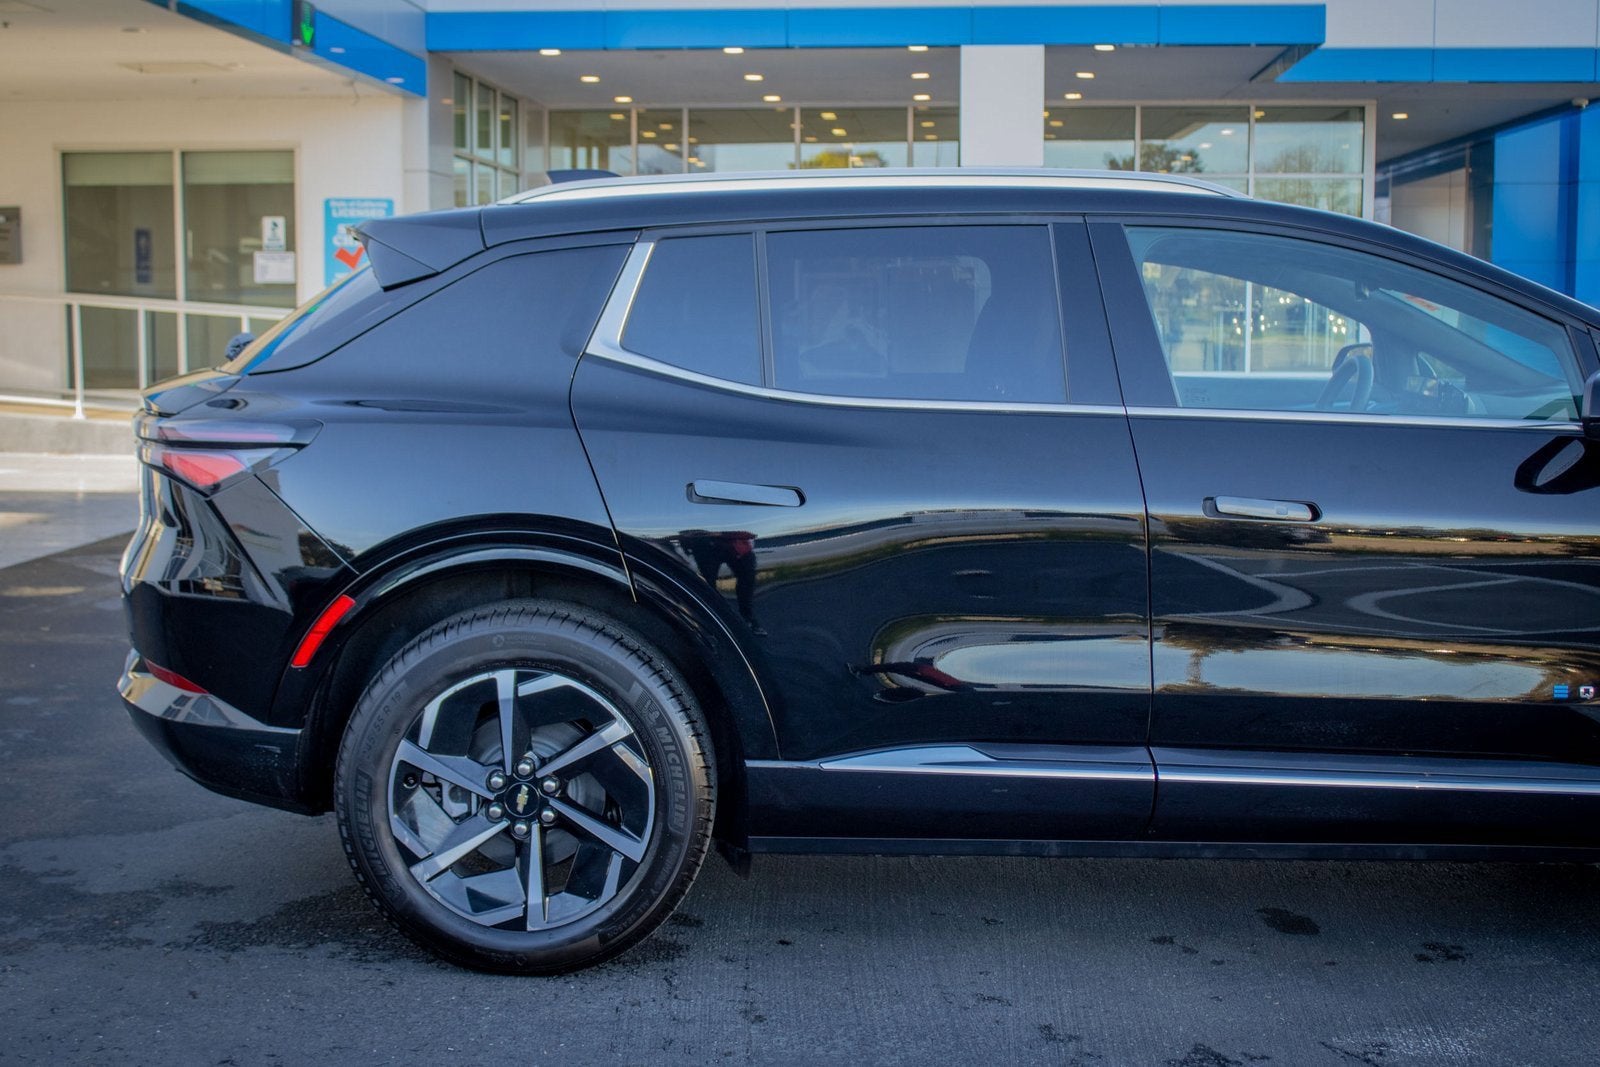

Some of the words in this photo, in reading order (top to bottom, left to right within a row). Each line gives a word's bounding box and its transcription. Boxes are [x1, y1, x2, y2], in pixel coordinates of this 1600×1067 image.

[331, 208, 386, 218] LICENSED
[355, 774, 386, 876] MICHELIN
[656, 726, 686, 828] MICHELIN
